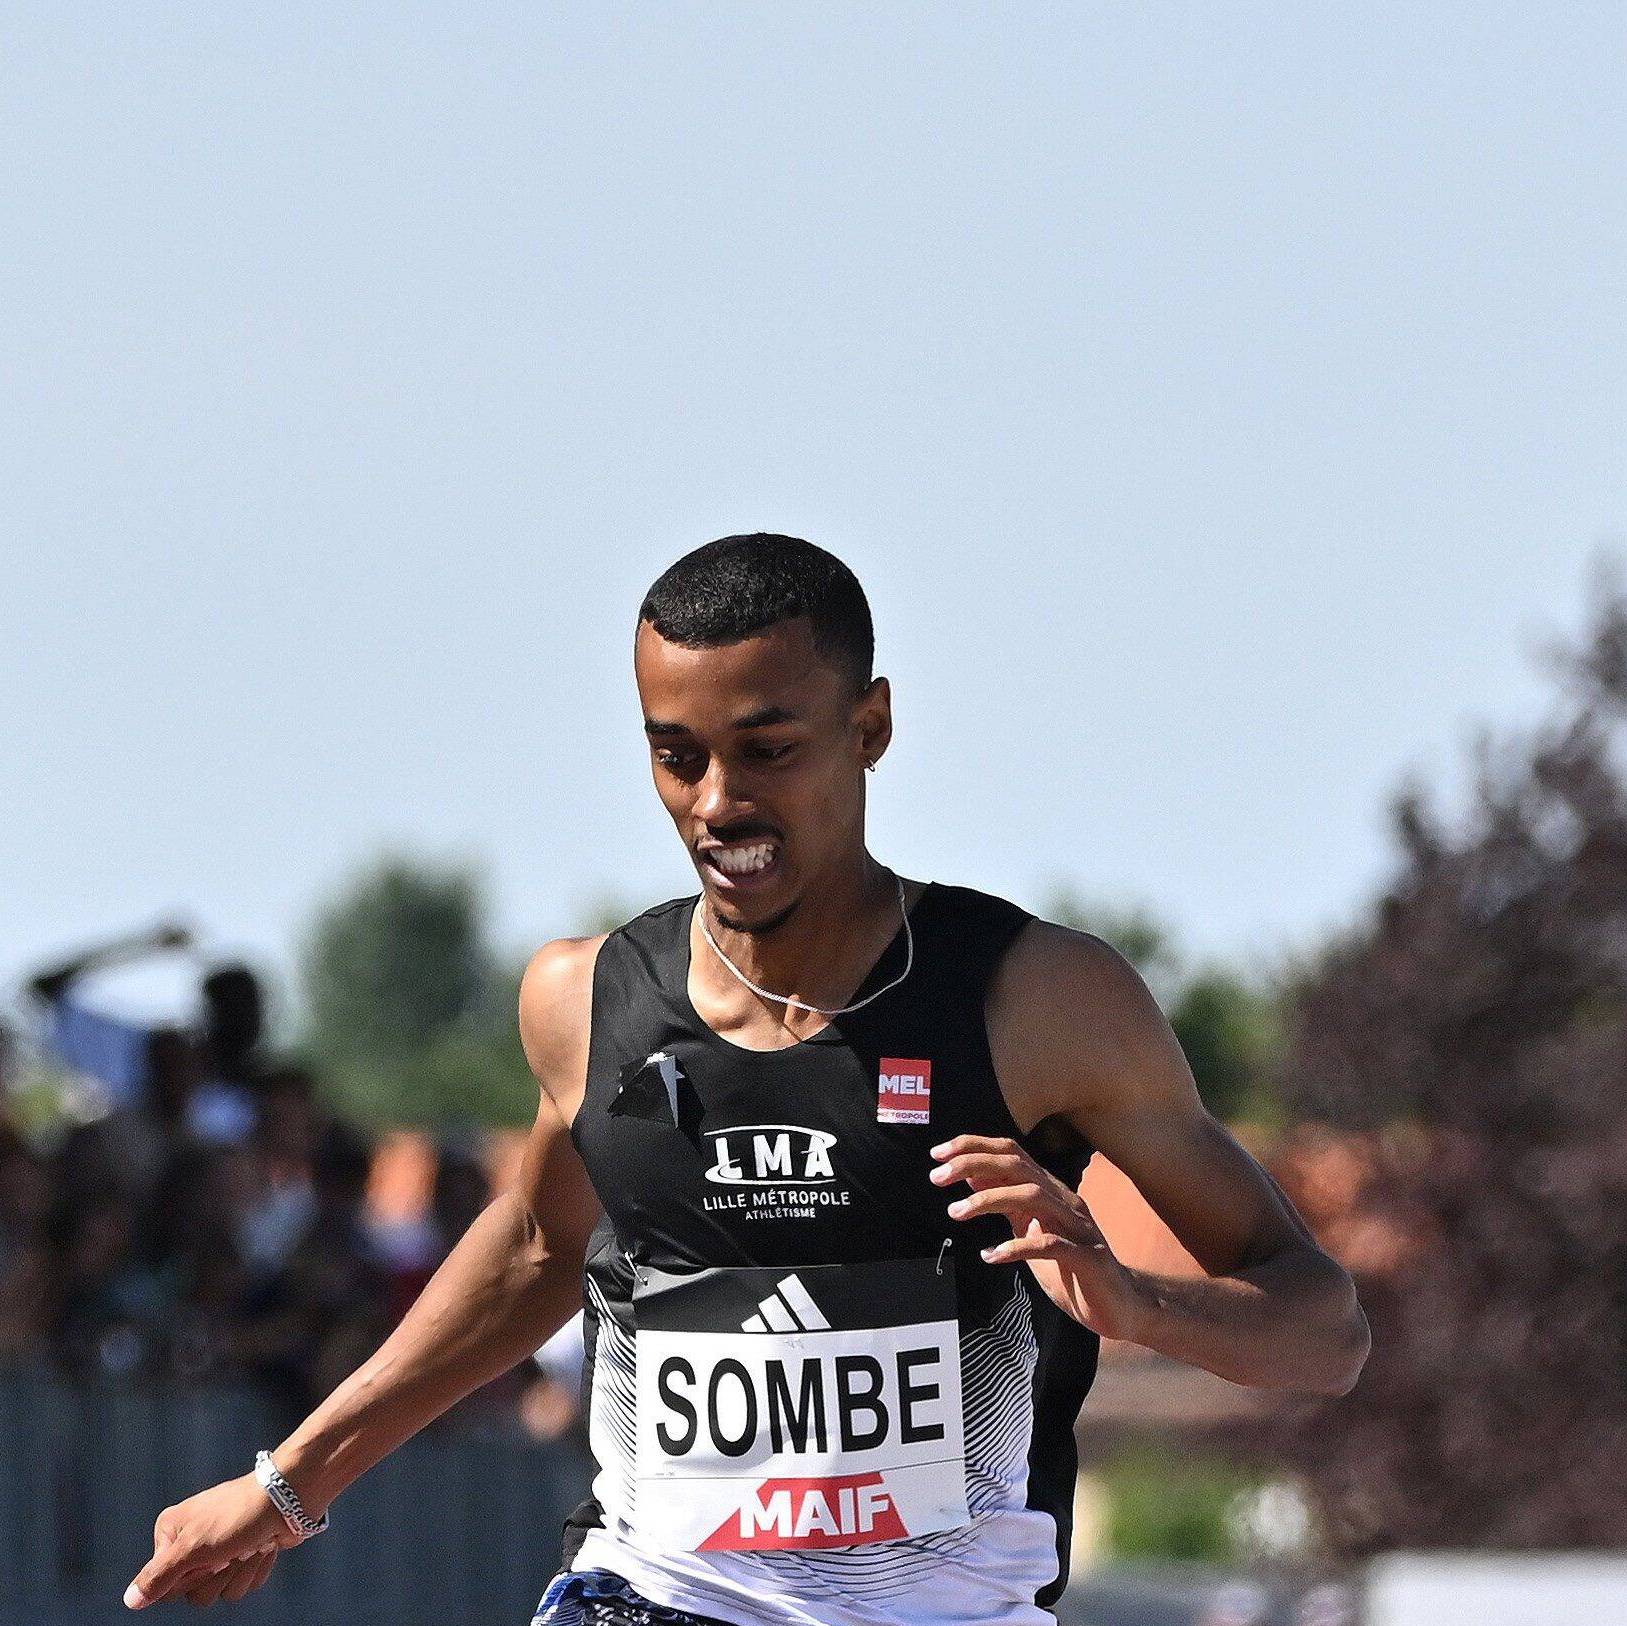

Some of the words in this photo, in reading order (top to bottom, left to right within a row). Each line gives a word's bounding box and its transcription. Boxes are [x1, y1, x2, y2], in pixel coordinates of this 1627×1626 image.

[878, 1074, 931, 1096] MEL
[702, 1192, 748, 1212] LILLE
[752, 1188, 851, 1208] MÉTROPOLE
[655, 1346, 946, 1458] SOMBE
[738, 1483, 893, 1539] MAIF
